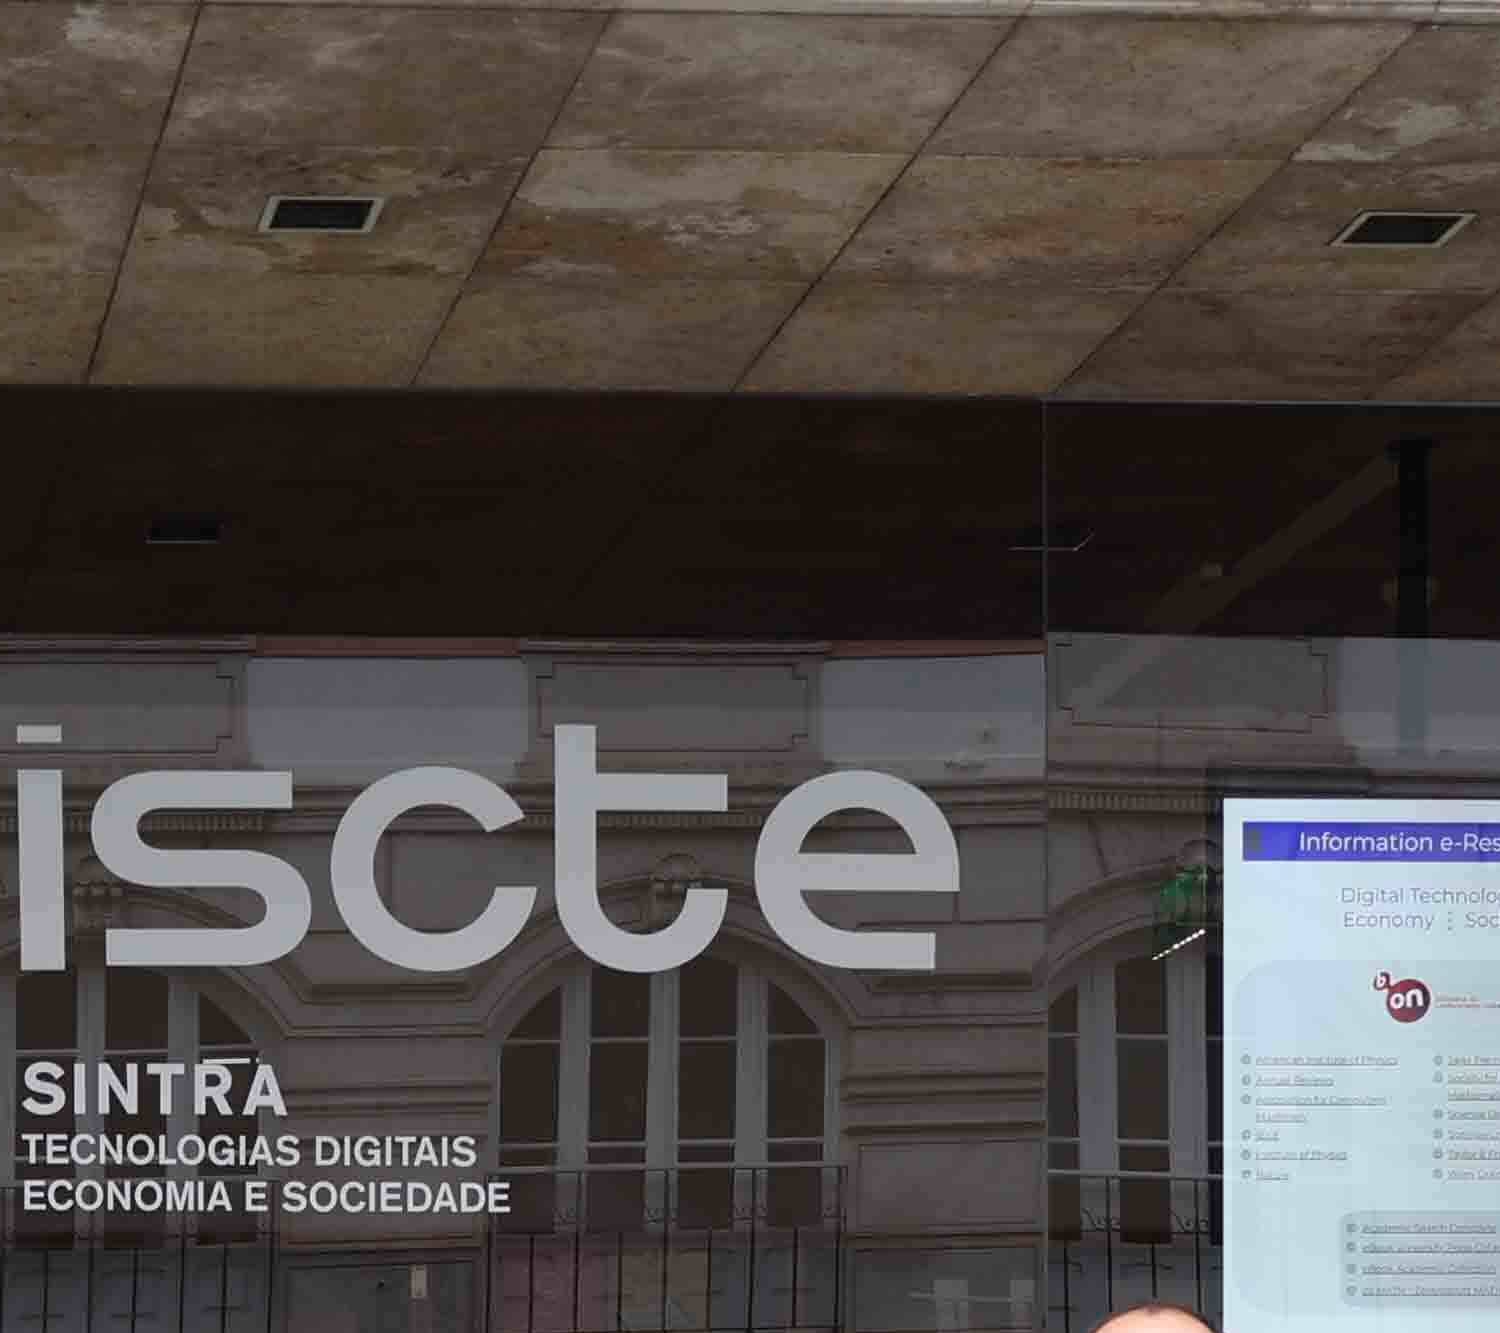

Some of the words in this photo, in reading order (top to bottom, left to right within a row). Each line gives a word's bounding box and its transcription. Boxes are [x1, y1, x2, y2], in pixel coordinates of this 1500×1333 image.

[15, 723, 961, 973] iscte
[1299, 832, 1433, 854] Information
[1341, 887, 1404, 908] Digital
[1343, 912, 1435, 933] Economy
[21, 1060, 289, 1117] SINTRA
[21, 1133, 301, 1168] TECNOLOGIAS
[314, 1134, 478, 1168] DIGITAIS
[22, 1178, 233, 1213] ECONOMIA
[244, 1179, 269, 1212] E
[281, 1179, 512, 1215] SOCIEDADE
